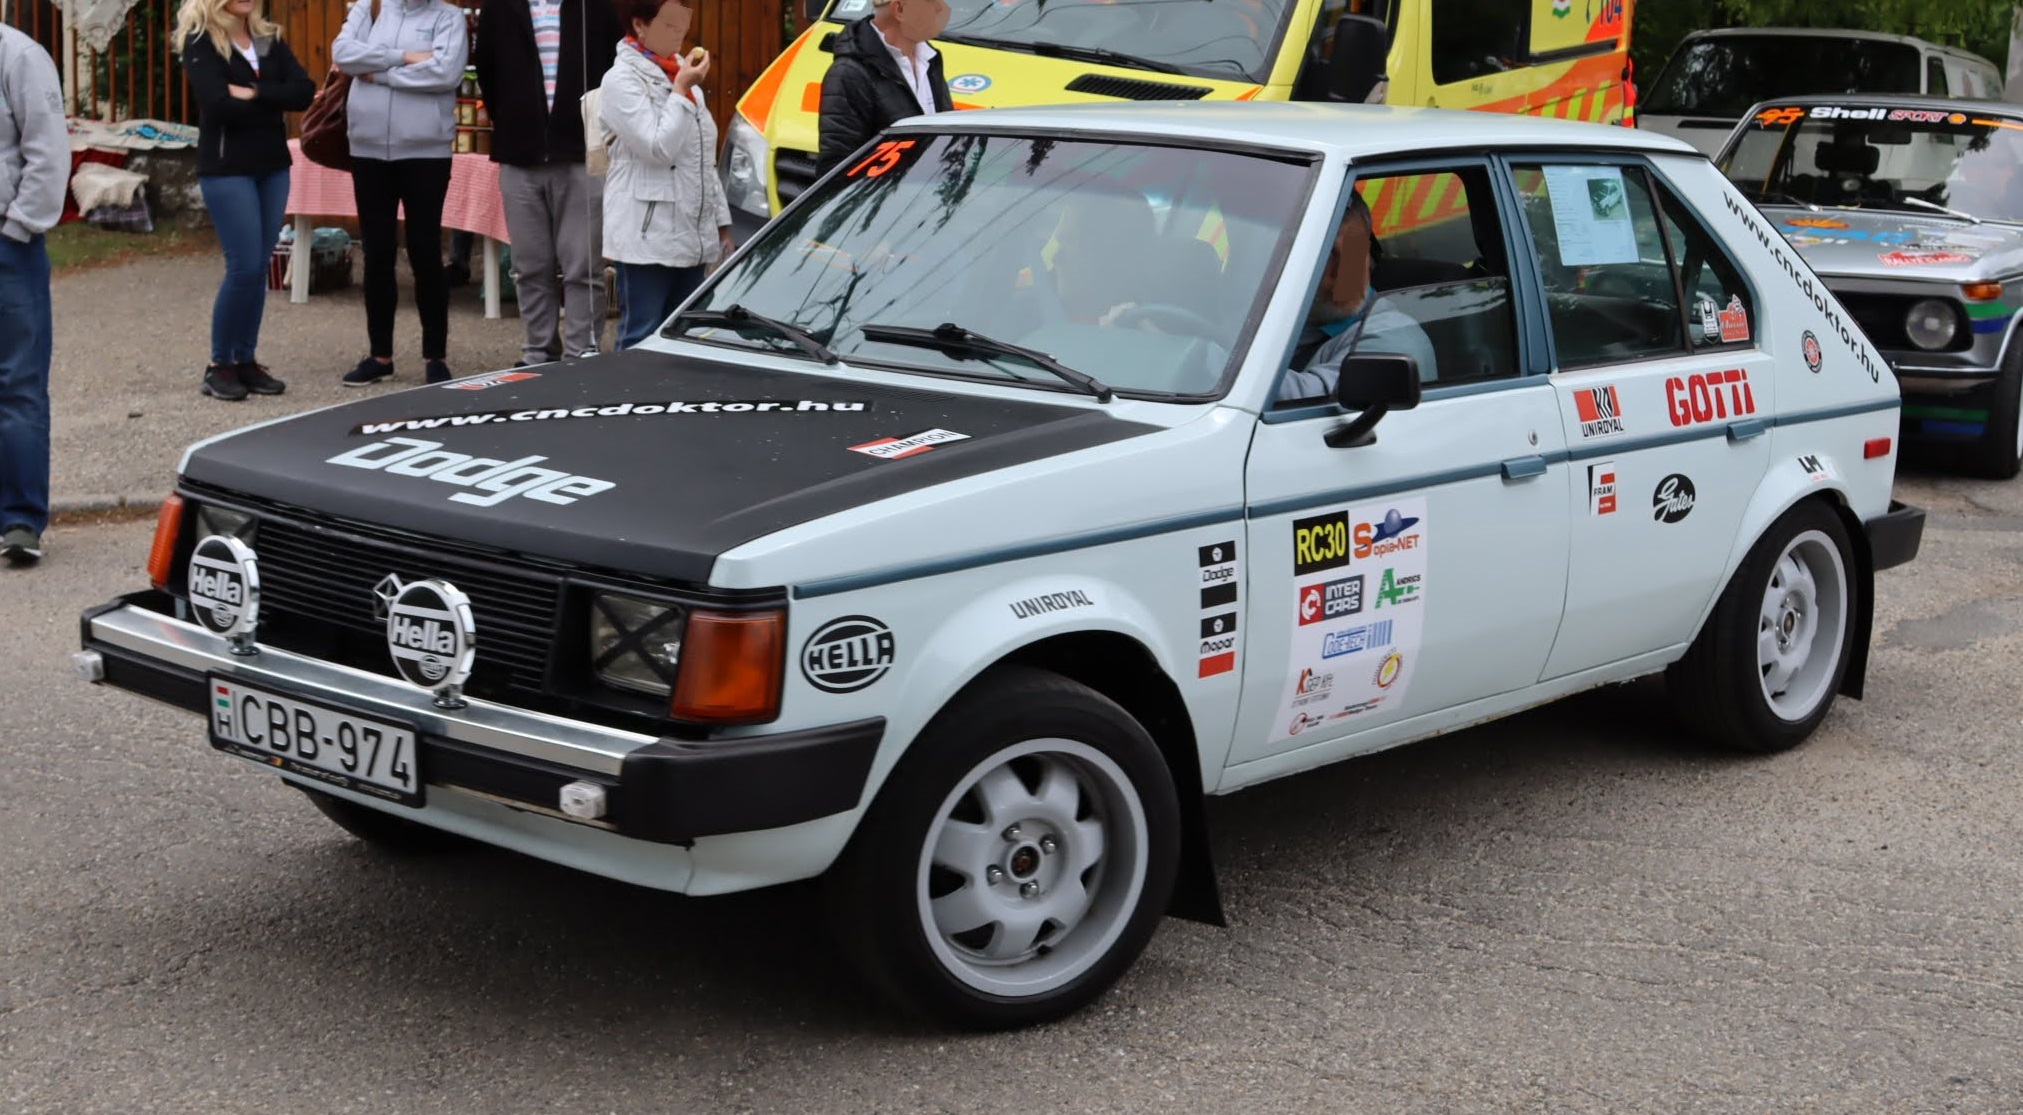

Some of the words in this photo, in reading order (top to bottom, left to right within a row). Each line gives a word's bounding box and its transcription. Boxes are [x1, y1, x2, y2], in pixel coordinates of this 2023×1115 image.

[1762, 107, 1801, 126] 95
[1809, 106, 1887, 120] Shell
[1888, 109, 1949, 123] SPORT
[846, 140, 917, 177] 75
[1723, 190, 1880, 385] www.cncdoktor.hu
[362, 400, 864, 435] www.cncdoktor.hu
[1581, 421, 1624, 437] UNIROYAL
[868, 430, 957, 456] CHAMPION
[325, 436, 617, 507] Dodge
[1593, 484, 1613, 496] FRAM
[1296, 521, 1347, 565] RC30
[192, 564, 242, 605] Hella
[1202, 566, 1234, 582] Dodge
[1009, 589, 1095, 620] UNIROYAL
[1325, 580, 1361, 600] INTER
[1325, 595, 1360, 615] CARS
[392, 615, 456, 655] Hella
[1201, 637, 1235, 654] Mopar
[808, 630, 895, 672] HELLA
[217, 712, 232, 737] H
[242, 695, 410, 787] CBB-974
